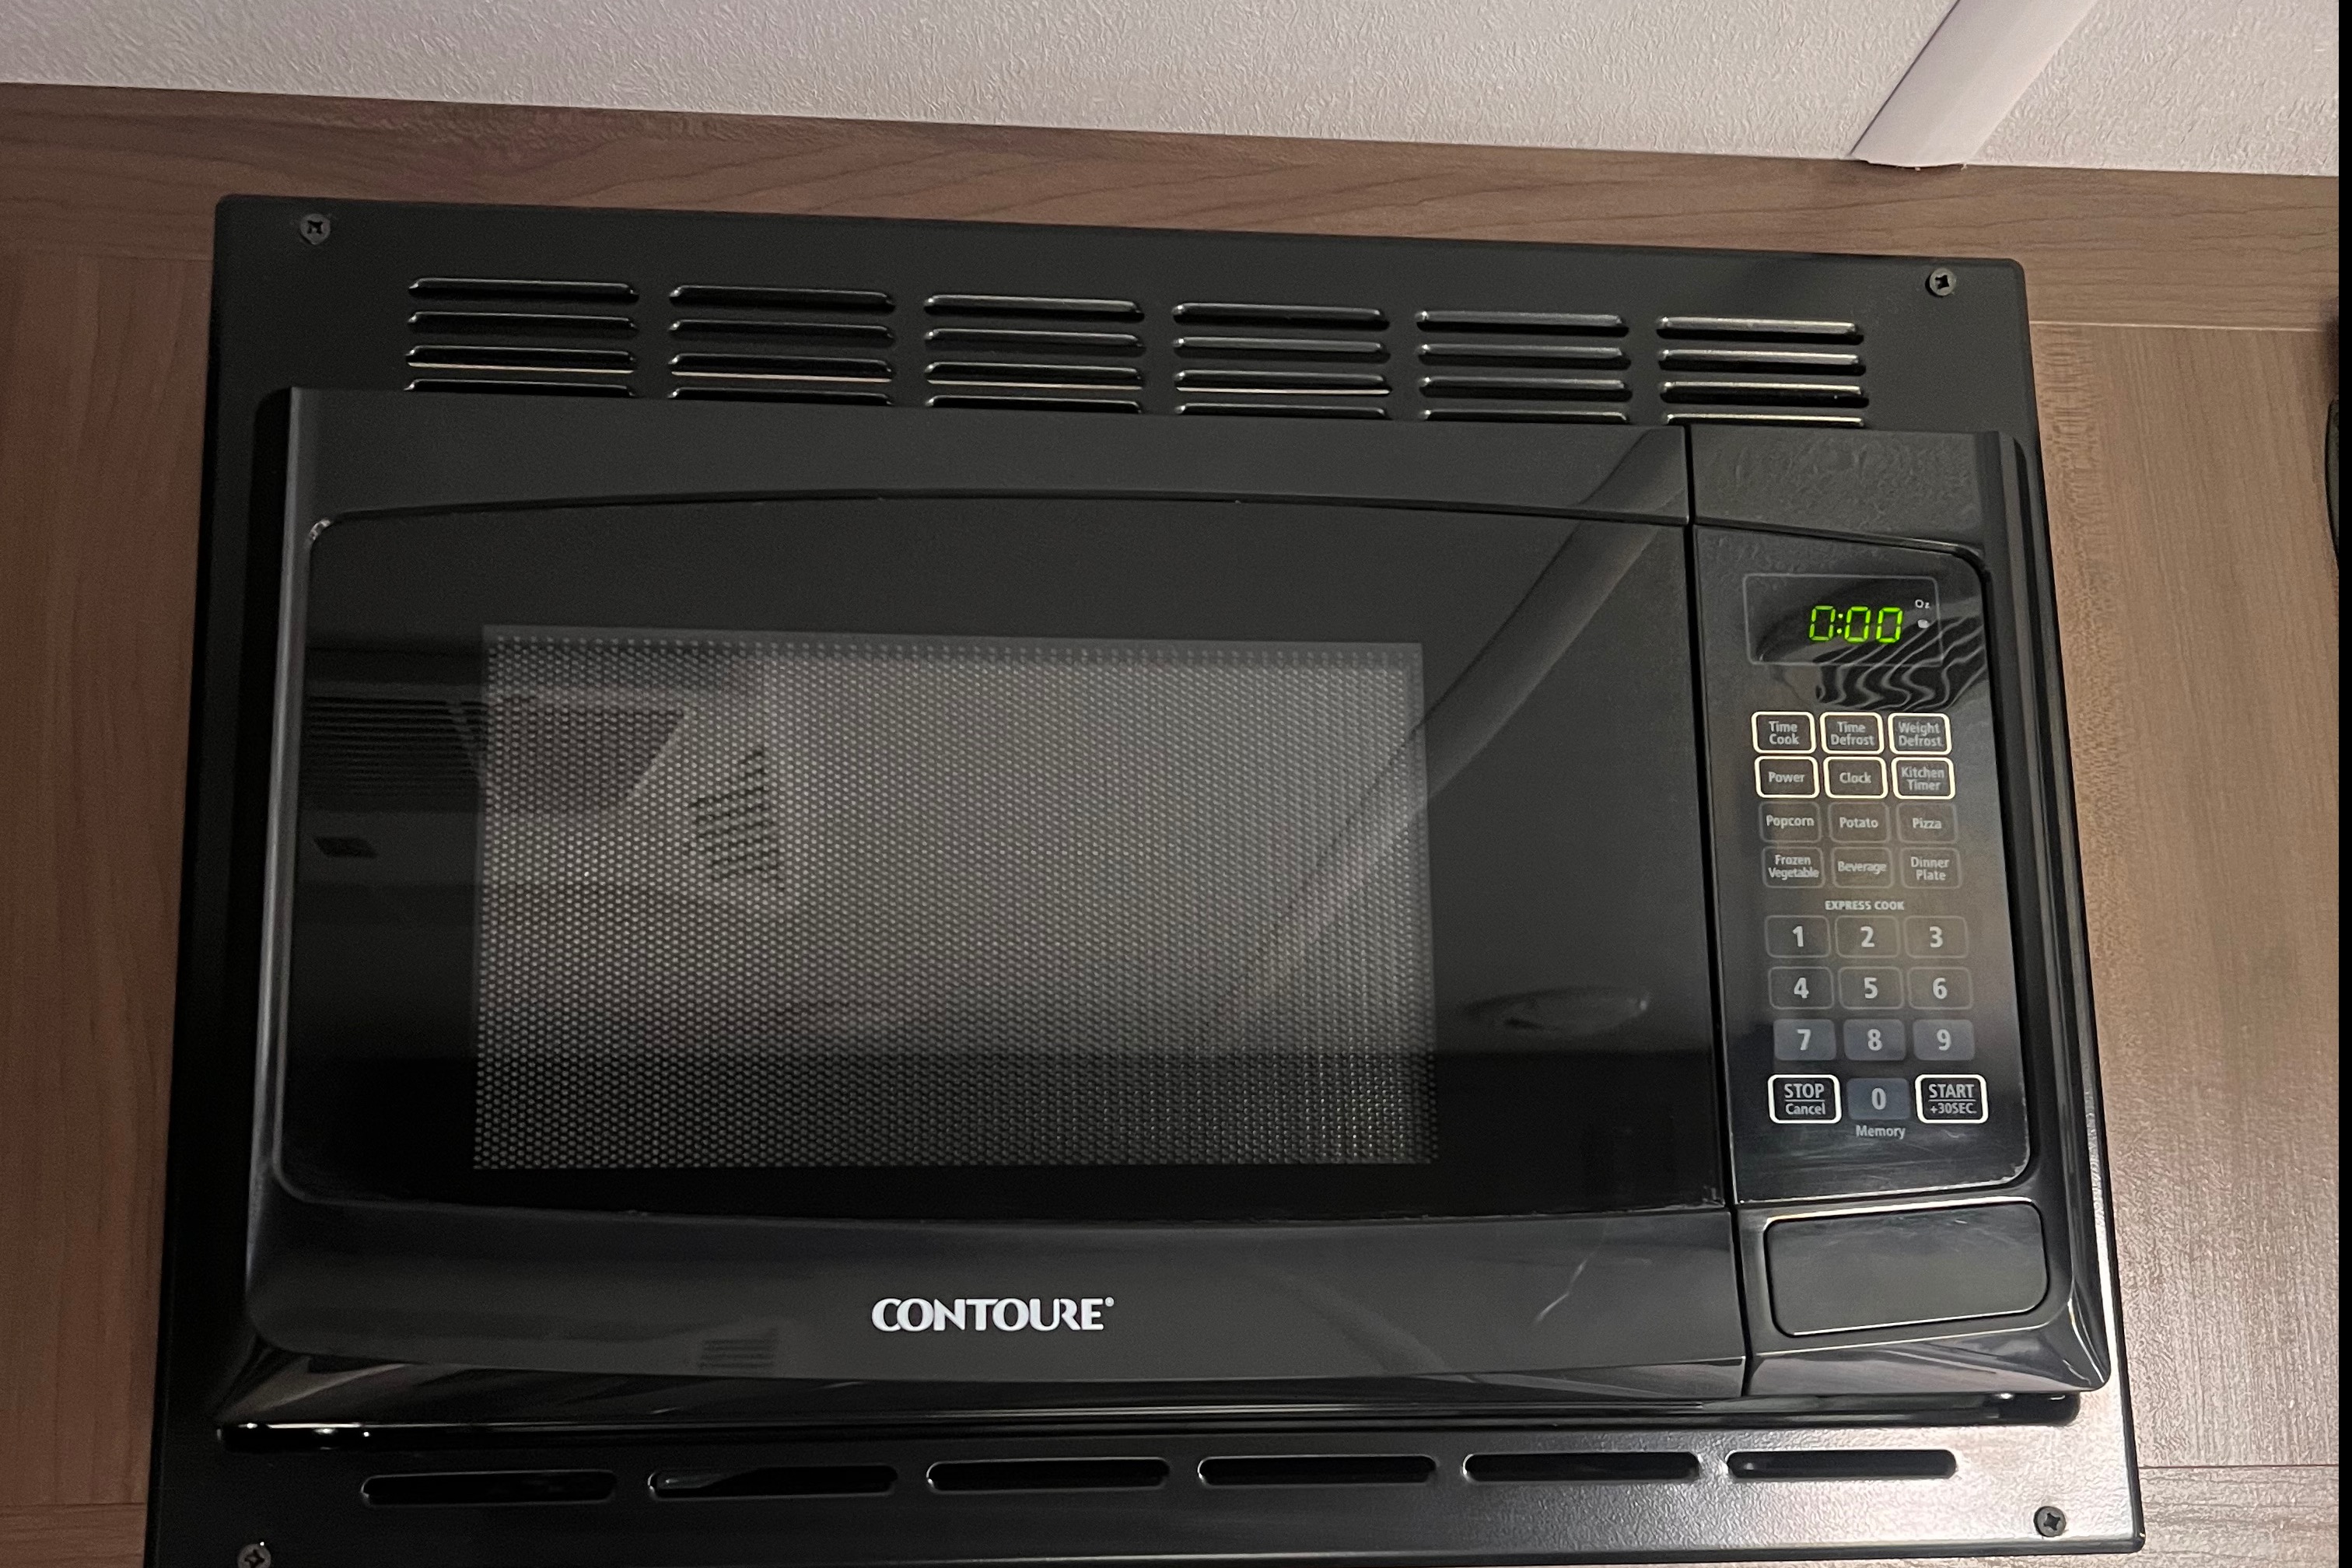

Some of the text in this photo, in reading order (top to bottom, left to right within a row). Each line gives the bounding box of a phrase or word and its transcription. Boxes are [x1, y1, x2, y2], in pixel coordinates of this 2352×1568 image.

[1809, 605, 1903, 643] 0:00
[1769, 721, 1797, 733] Time
[1837, 722, 1866, 733] Time
[1899, 722, 1940, 735] Weight
[1769, 734, 1800, 745] Cook
[1831, 734, 1874, 746] Defrost
[1899, 736, 1943, 747] Defrost
[1768, 772, 1805, 783] Power
[1839, 772, 1871, 784] Clock
[1902, 767, 1945, 779] Kitchen
[1907, 779, 1941, 791] Timer
[1766, 815, 1815, 828] Popcorn
[1839, 817, 1878, 829] Potato
[1912, 817, 1942, 830] Pizza
[1775, 855, 1811, 866] Frozen
[1911, 857, 1950, 869] Dinner
[1769, 867, 1820, 880] Vegetable
[1838, 861, 1887, 874] Beverage
[1916, 870, 1946, 881] Plate
[1825, 901, 1905, 911] EXPRESS COOK
[1792, 926, 1804, 947] 1
[1860, 926, 1875, 947] 2
[1929, 926, 1944, 948] 3
[1794, 978, 1809, 999] 4
[1864, 978, 1878, 999] 5
[1932, 978, 1948, 999] 6
[1797, 1029, 1811, 1051] 7
[1867, 1029, 1883, 1051] 8
[1936, 1029, 1951, 1051] 9
[1784, 1083, 1825, 1098] STOP
[1928, 1084, 1975, 1098] START
[1871, 1088, 1886, 1110] 0
[1785, 1102, 1826, 1115] Cancel
[1855, 1125, 1906, 1139] Memory
